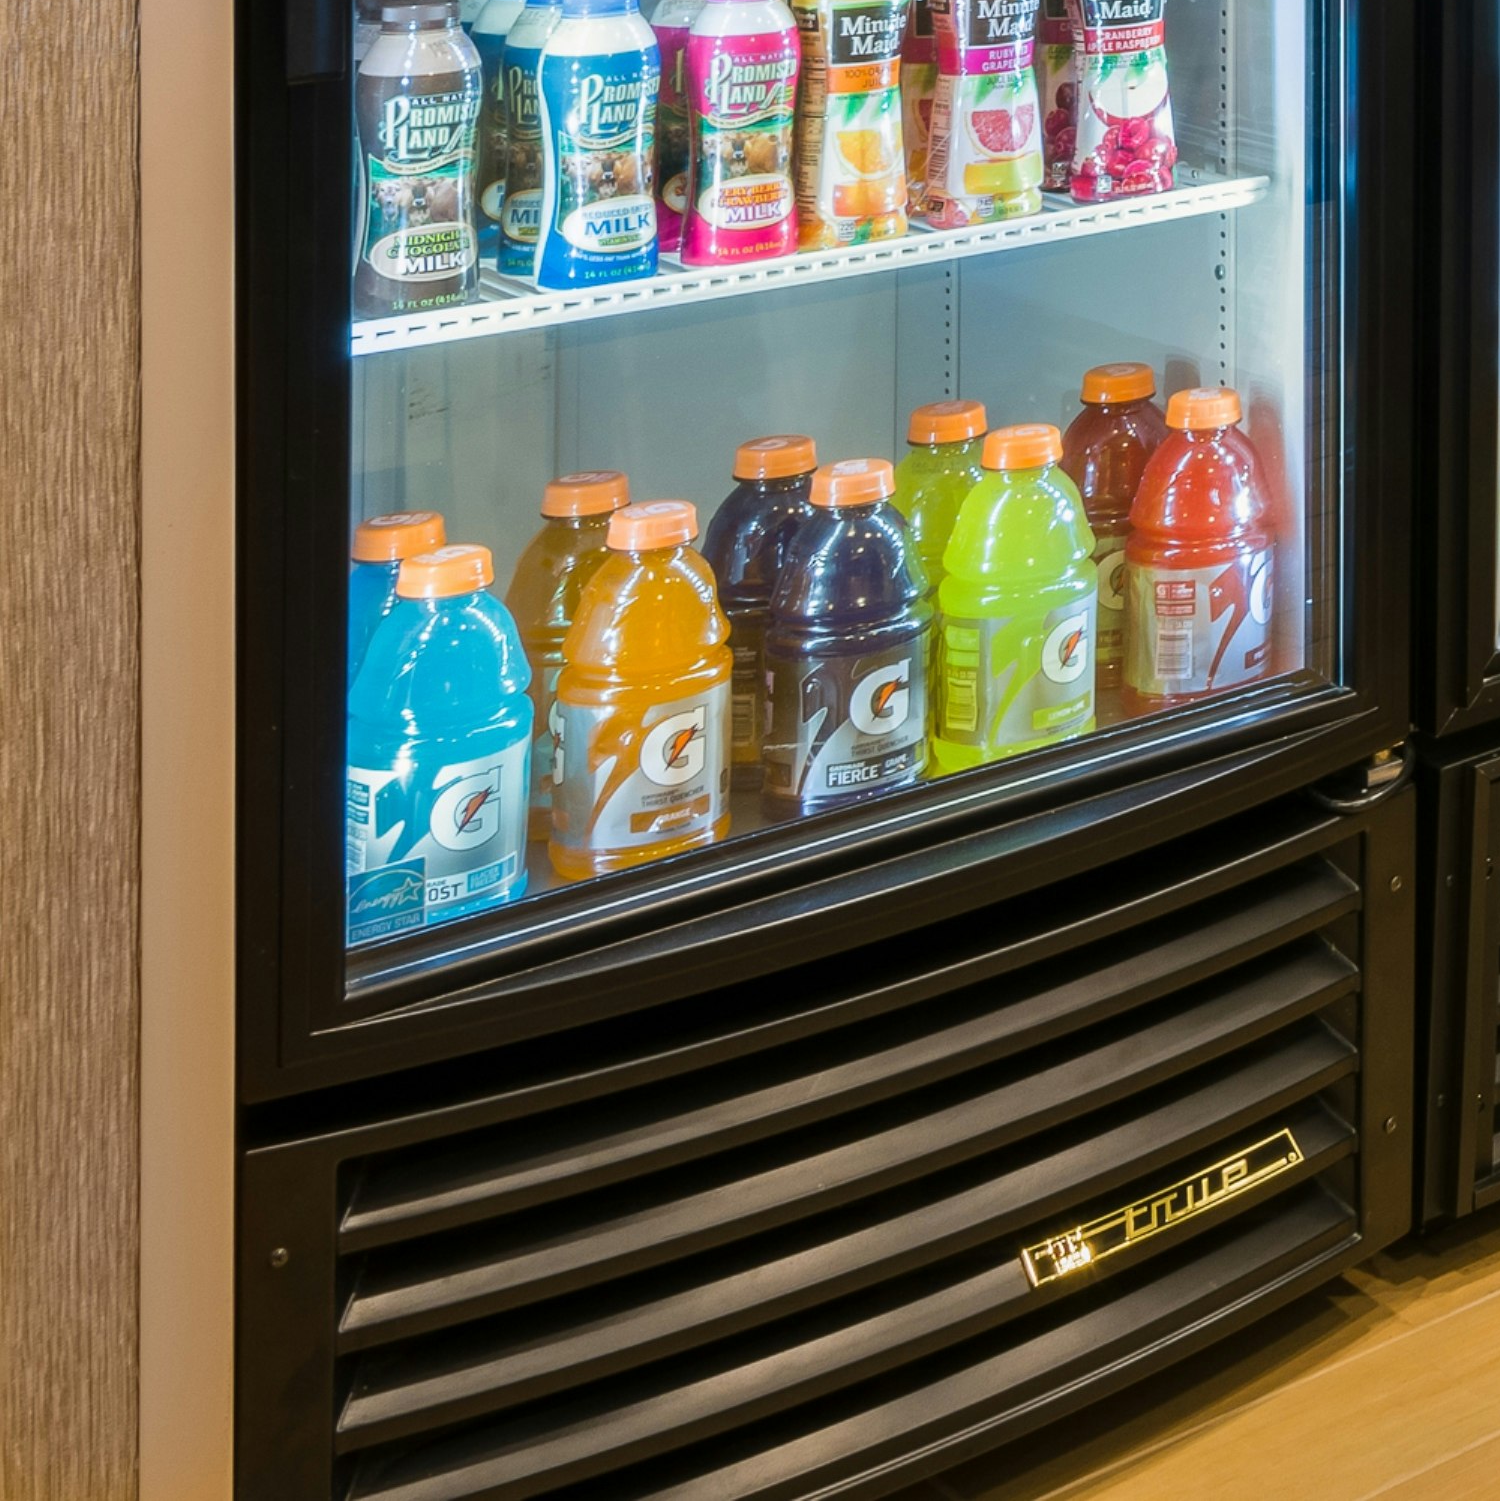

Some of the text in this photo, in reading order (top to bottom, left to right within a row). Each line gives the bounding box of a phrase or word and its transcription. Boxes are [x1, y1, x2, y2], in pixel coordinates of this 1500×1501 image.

[1101, 0, 1152, 19] Maid
[840, 13, 907, 37] Minute
[851, 34, 899, 56] Maid
[584, 213, 650, 236] MILK
[399, 255, 466, 274] MILK
[640, 704, 708, 786] G
[828, 766, 879, 787] FIERCE
